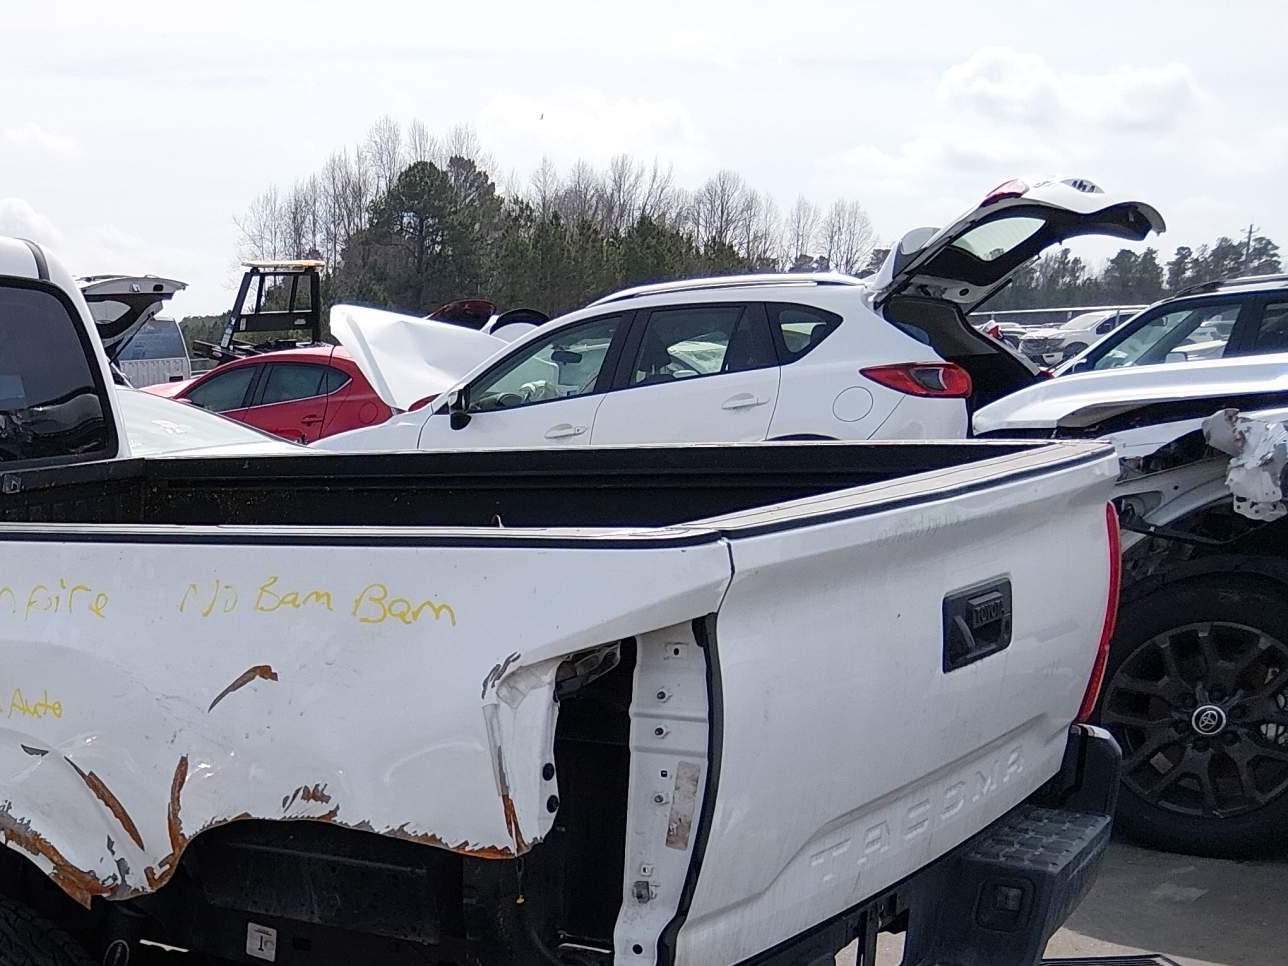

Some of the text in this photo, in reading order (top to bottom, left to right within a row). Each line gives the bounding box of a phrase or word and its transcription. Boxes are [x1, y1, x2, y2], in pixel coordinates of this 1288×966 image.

[254, 575, 334, 612] Bam
[351, 583, 457, 627] Bam
[8, 687, 64, 720] Auto
[809, 743, 1026, 882] TACOMA
